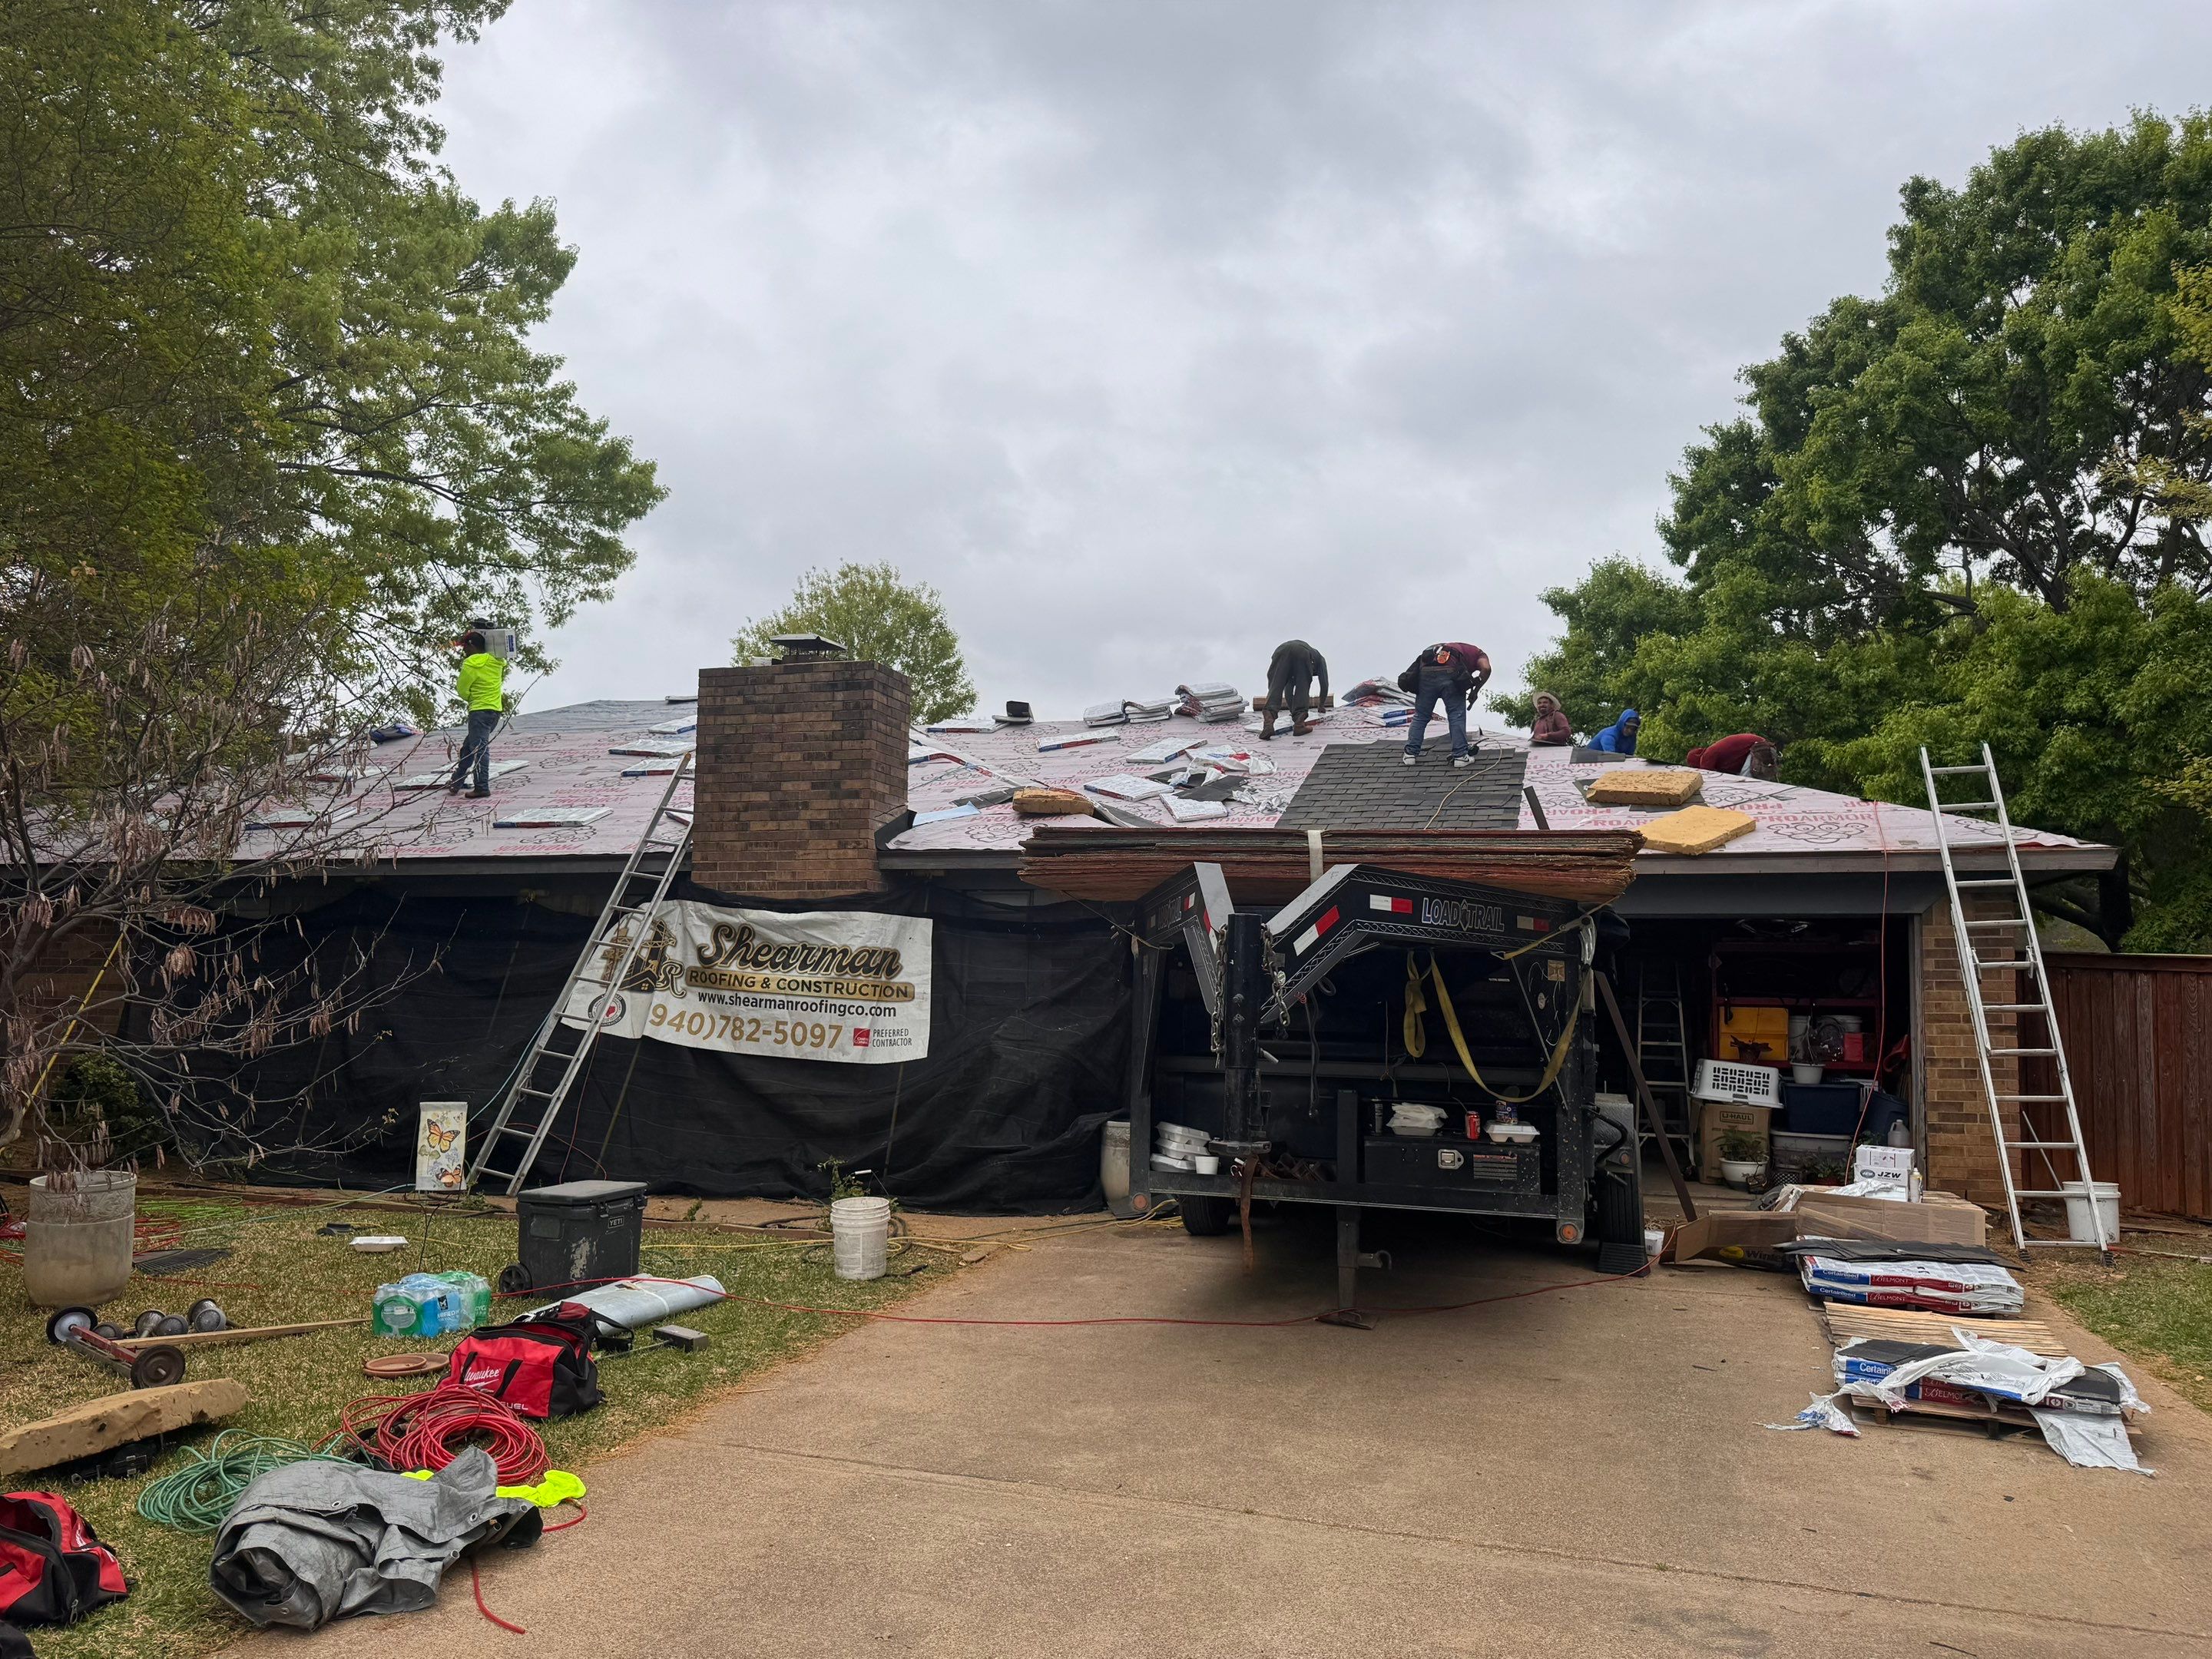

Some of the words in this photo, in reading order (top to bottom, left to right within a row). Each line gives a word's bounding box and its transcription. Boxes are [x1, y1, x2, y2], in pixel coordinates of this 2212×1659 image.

[1753, 813, 1874, 823] PROARMOR
[1422, 897, 1460, 926] LOAD
[1466, 904, 1505, 932] TRAIL
[697, 922, 903, 979] Shearman
[689, 969, 756, 988] ROOFING
[760, 976, 771, 988] &
[776, 978, 909, 998] CONSTRUCTION
[697, 991, 897, 1018] www.shearmanroofingco.com
[873, 1028, 909, 1038] PREFERRED
[872, 1038, 912, 1048] CONTRACTOR
[1873, 1275, 1908, 1283] BELMONT
[1869, 1293, 1906, 1302] BELMONT
